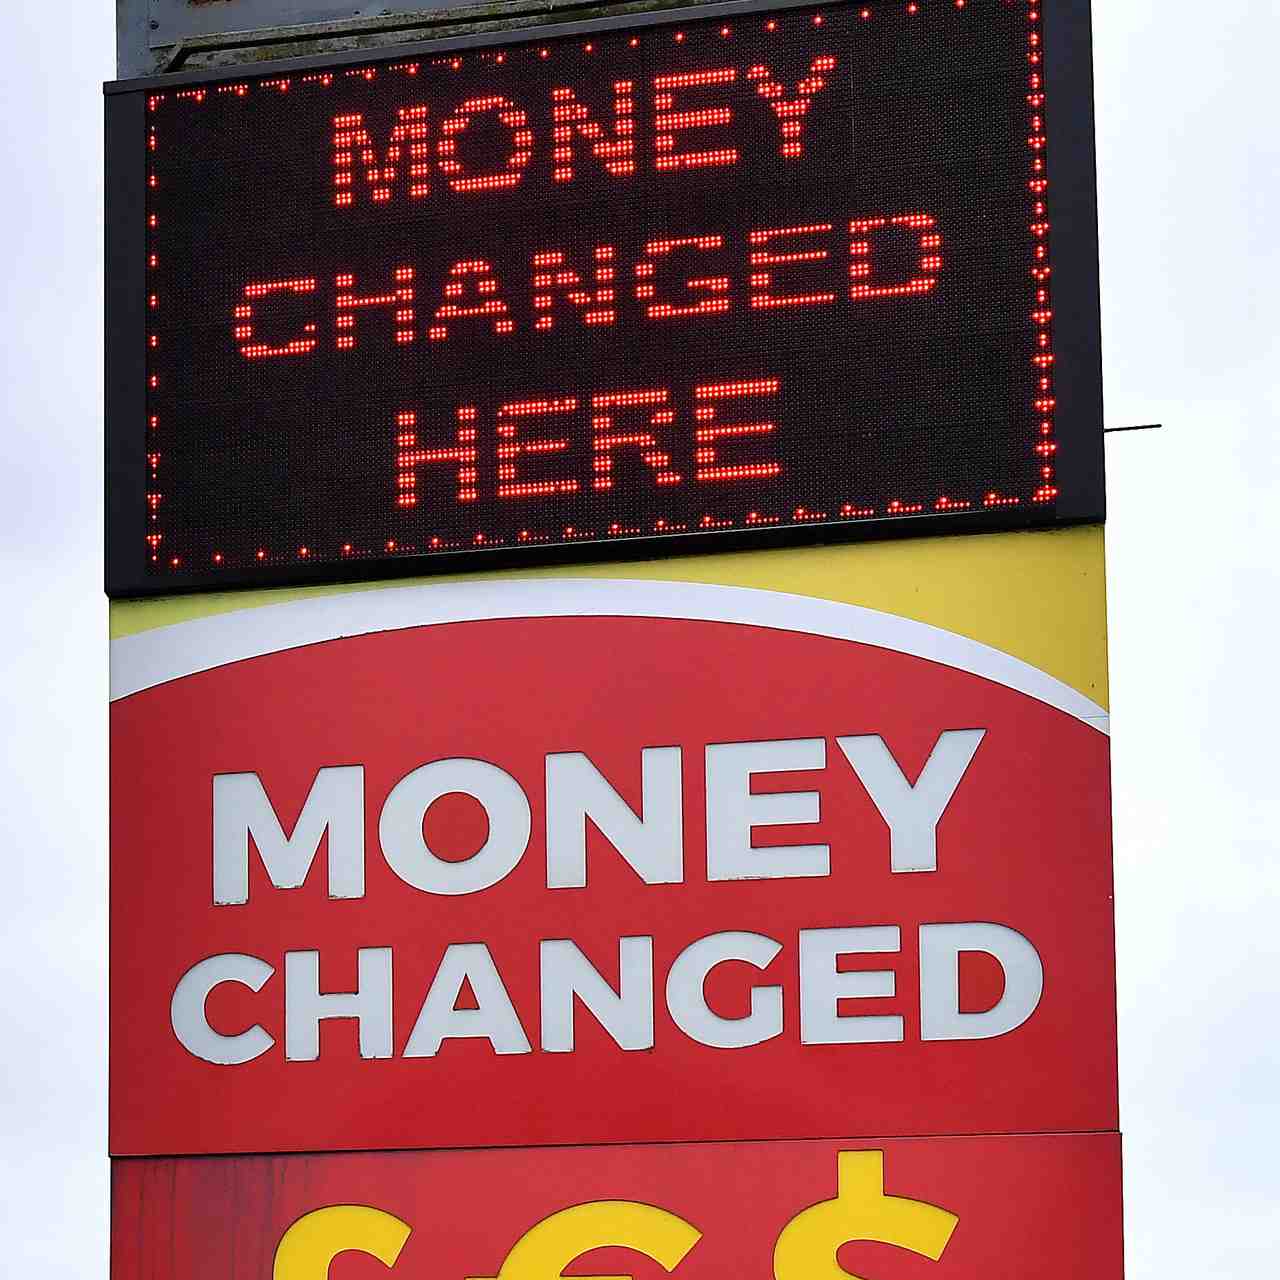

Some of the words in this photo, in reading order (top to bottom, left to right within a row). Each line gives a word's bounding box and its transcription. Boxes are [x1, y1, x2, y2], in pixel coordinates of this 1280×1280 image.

[333, 54, 836, 207] MONEY
[234, 212, 942, 358] CHANGED
[397, 378, 782, 506] HERE
[212, 728, 988, 907] MONEY
[168, 921, 1045, 1066] CHANGED
